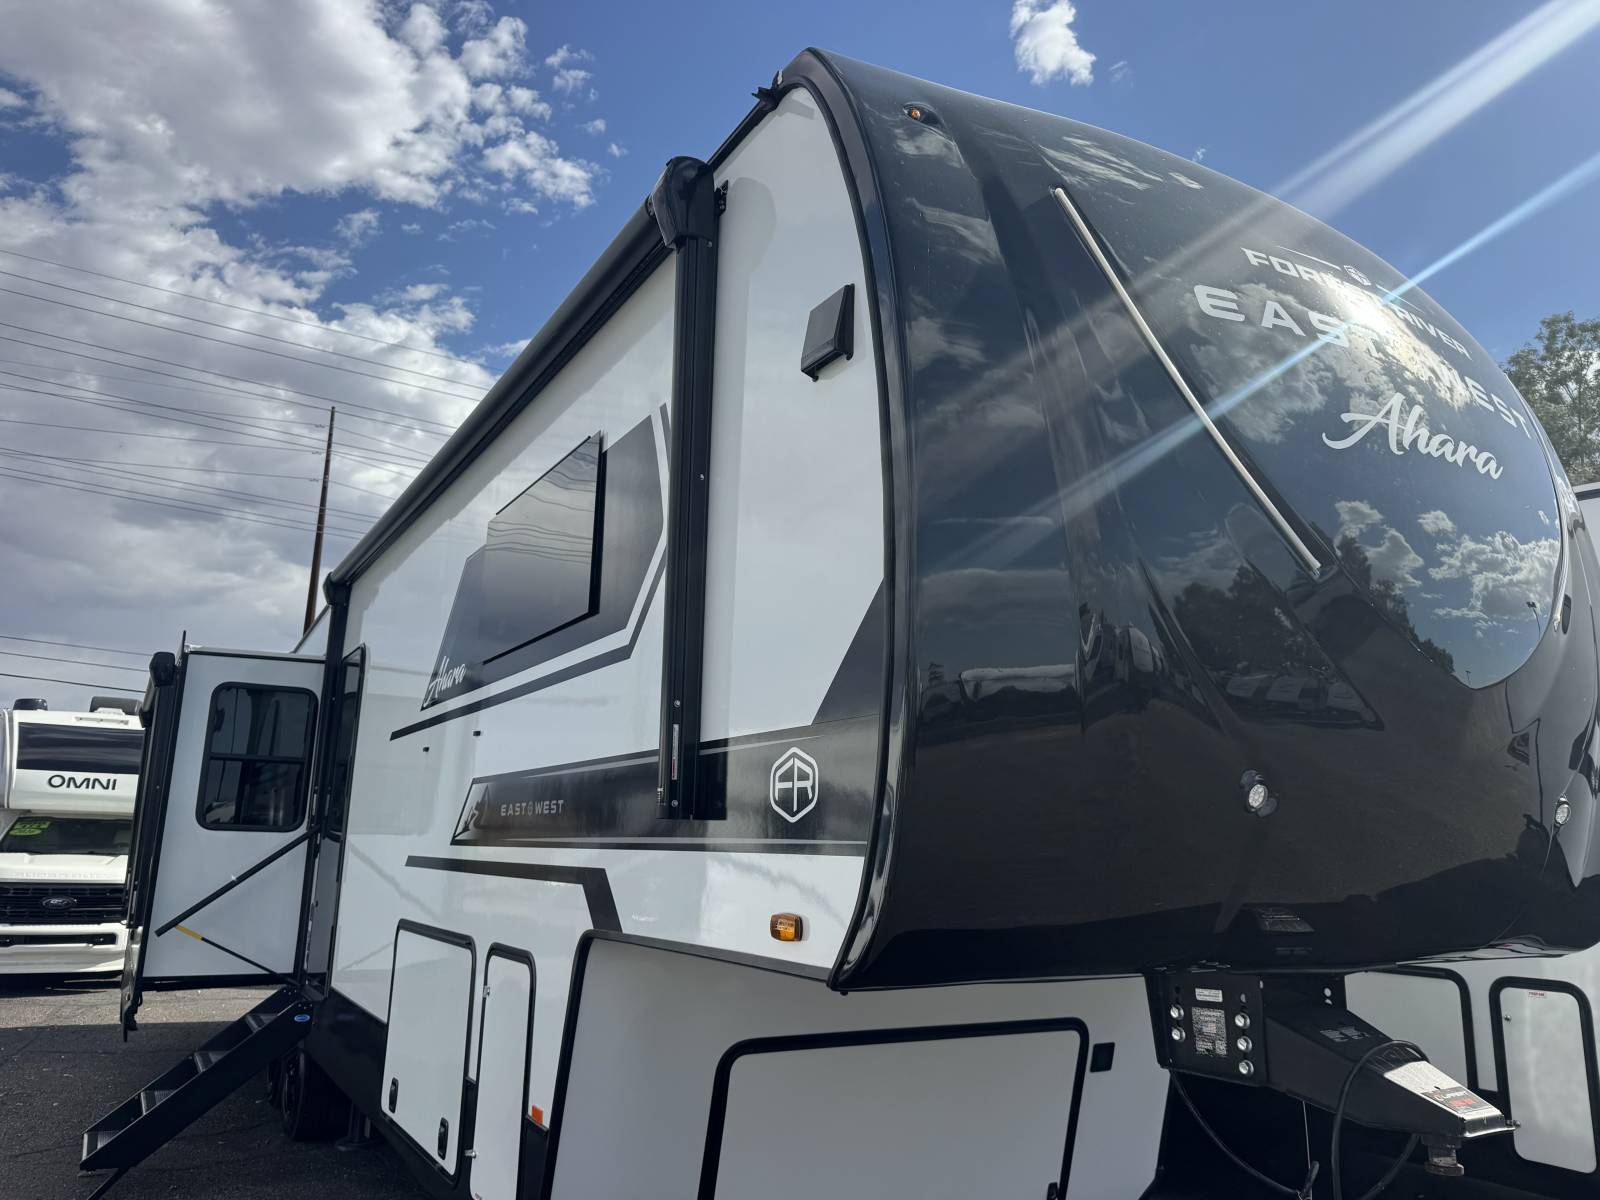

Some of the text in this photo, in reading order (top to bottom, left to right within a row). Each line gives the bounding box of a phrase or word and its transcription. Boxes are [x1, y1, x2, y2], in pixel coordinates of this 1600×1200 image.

[1194, 284, 1381, 358] EAST
[1389, 302, 1473, 361] RIVER
[1322, 392, 1504, 480] Ahara
[423, 655, 467, 707] Ahara
[47, 774, 117, 791] OMNI
[500, 799, 564, 816] EAST WEST
